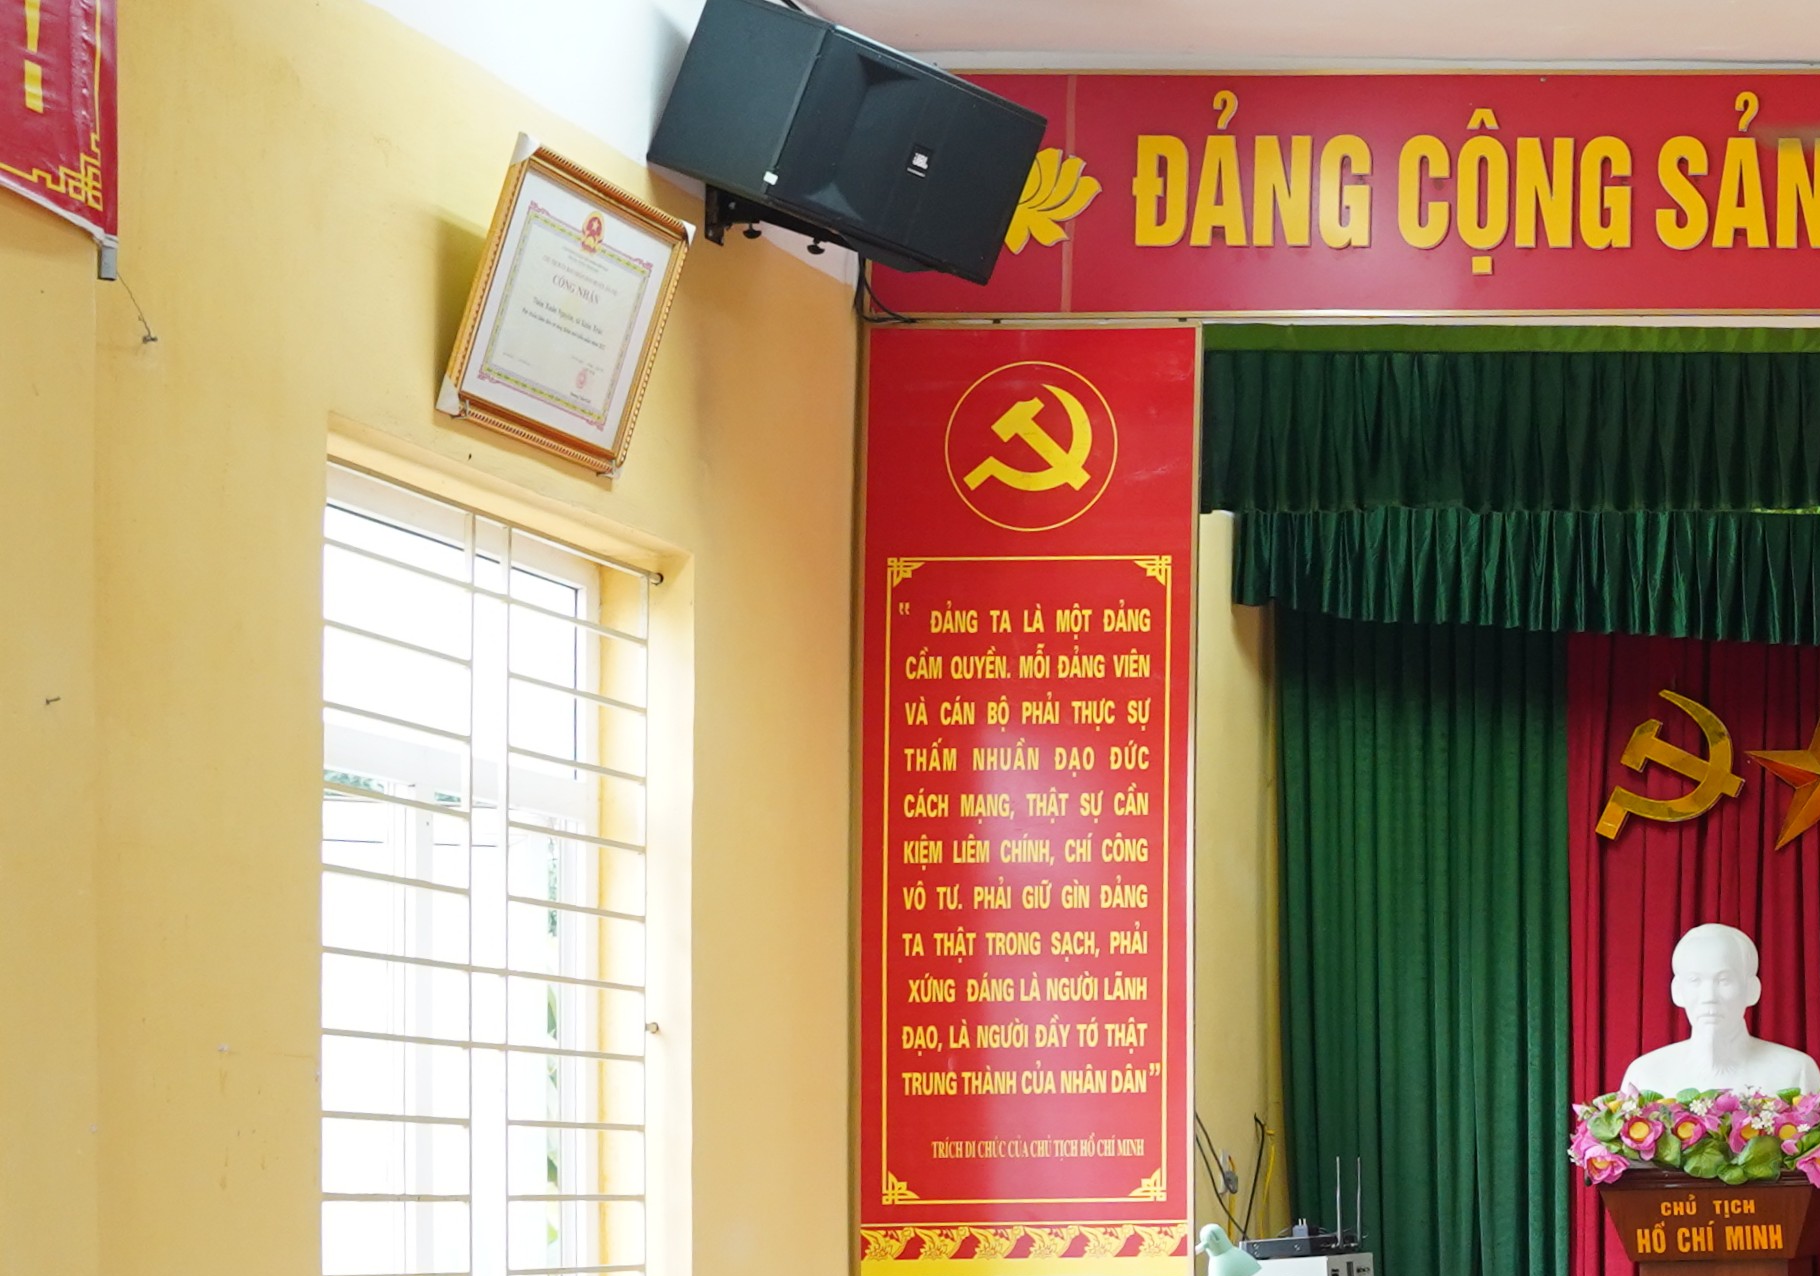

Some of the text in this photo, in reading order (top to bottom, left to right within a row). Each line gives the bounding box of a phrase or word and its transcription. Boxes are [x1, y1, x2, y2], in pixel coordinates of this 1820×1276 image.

[1132, 90, 1373, 250] ĐẢNG
[1398, 108, 1633, 277] CỘNG
[930, 601, 978, 633] ĐẢNG
[990, 610, 1011, 632] TA
[1024, 604, 1044, 632] LÀ
[1056, 603, 1092, 639] MỘT
[1103, 600, 1150, 632] ĐẢNG
[906, 644, 1150, 679] CẦM QUYỀN. MỖI ĐẢNG VIÊN
[905, 692, 1150, 732] VÀ CÁN BỘ PHẢI THỰC SỰ
[904, 738, 1149, 777] THẤM NHUẦN ĐẠO ĐỨC
[904, 783, 1148, 824] CÁCH MẠNG, THẬT SỰ CẦN
[904, 833, 1148, 870] KIỆM LIÊM CHÍNH, CHÍ CÔNG
[903, 875, 1147, 910] VÔ TƯ. PHẢI GIỮ GÌN ĐẢNG
[902, 921, 1147, 963] TA THẬT TRONG SẠCH, PHẢI
[909, 971, 1147, 1002] XỨNG ĐÁNG LÀ NGƯỜI LÃNH
[902, 1015, 1148, 1056] ĐẠO, LÀ NGƯỜI ĐẦY TỚ THẬT
[902, 1071, 957, 1095] TRUNG
[961, 1065, 1017, 1095] THÀNH
[1021, 1060, 1056, 1094] CỦA
[1061, 1064, 1106, 1093] NHÂN
[931, 1136, 963, 1158] TRÍCH
[965, 1141, 975, 1158] DI
[978, 1135, 1006, 1158] CHÚC
[1030, 1134, 1052, 1157] CHỦ
[1053, 1140, 1078, 1161] TỊCH
[1081, 1132, 1095, 1157] HỒ
[1097, 1134, 1115, 1156] CHÍ
[1117, 1139, 1144, 1156] MINH
[1660, 1194, 1755, 1218] CHỦ TỊCH
[1636, 1220, 1783, 1254] HỒ CHÍ MINH
